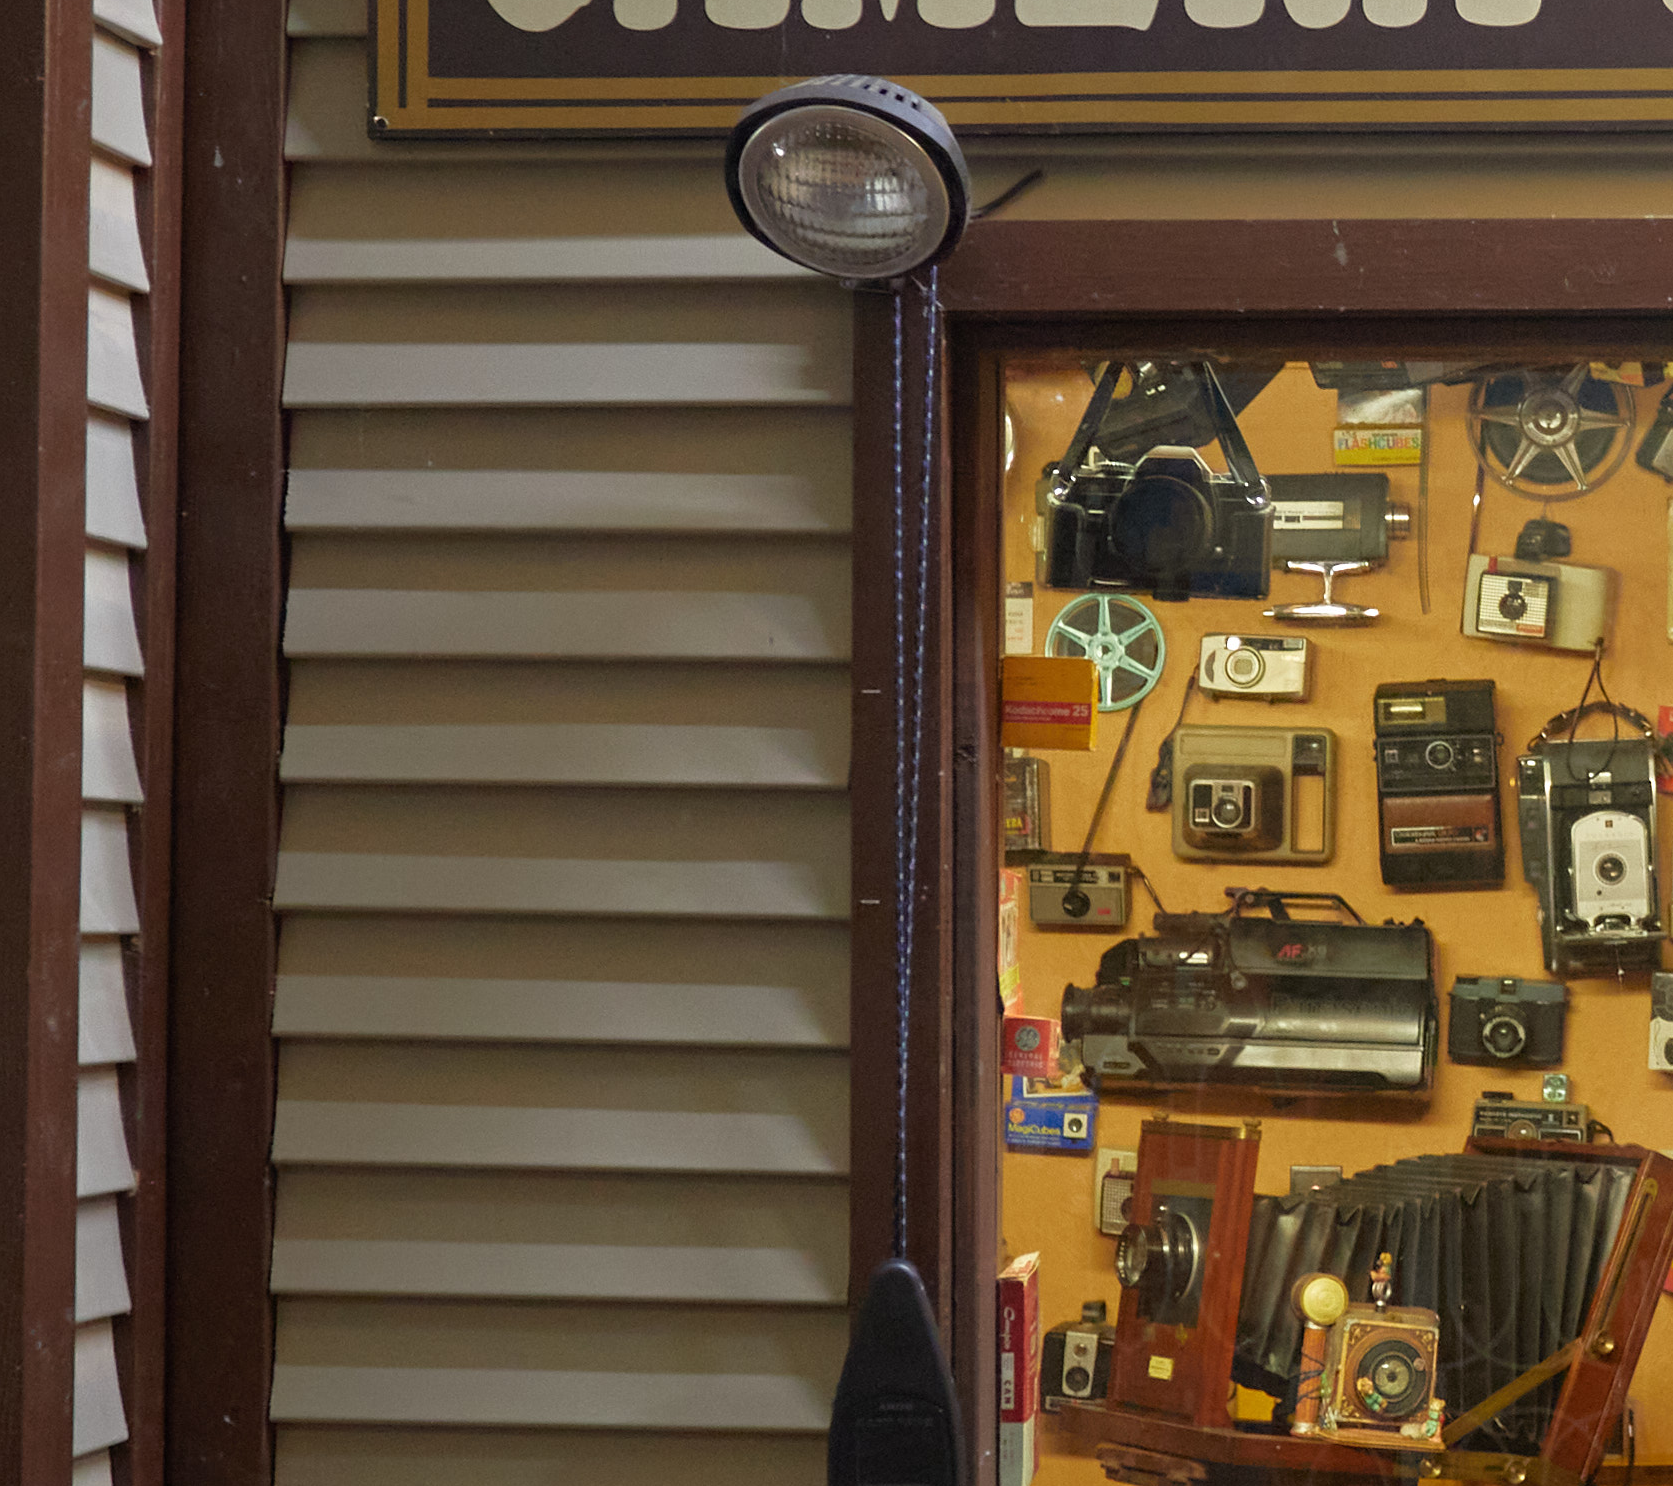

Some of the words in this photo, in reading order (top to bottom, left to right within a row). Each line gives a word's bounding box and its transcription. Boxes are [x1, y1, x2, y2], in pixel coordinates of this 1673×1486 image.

[1337, 437, 1421, 451] FLASHCUBES
[1073, 704, 1089, 717] 25
[1277, 942, 1306, 959] AF
[1008, 1123, 1061, 1137] MagiCubes
